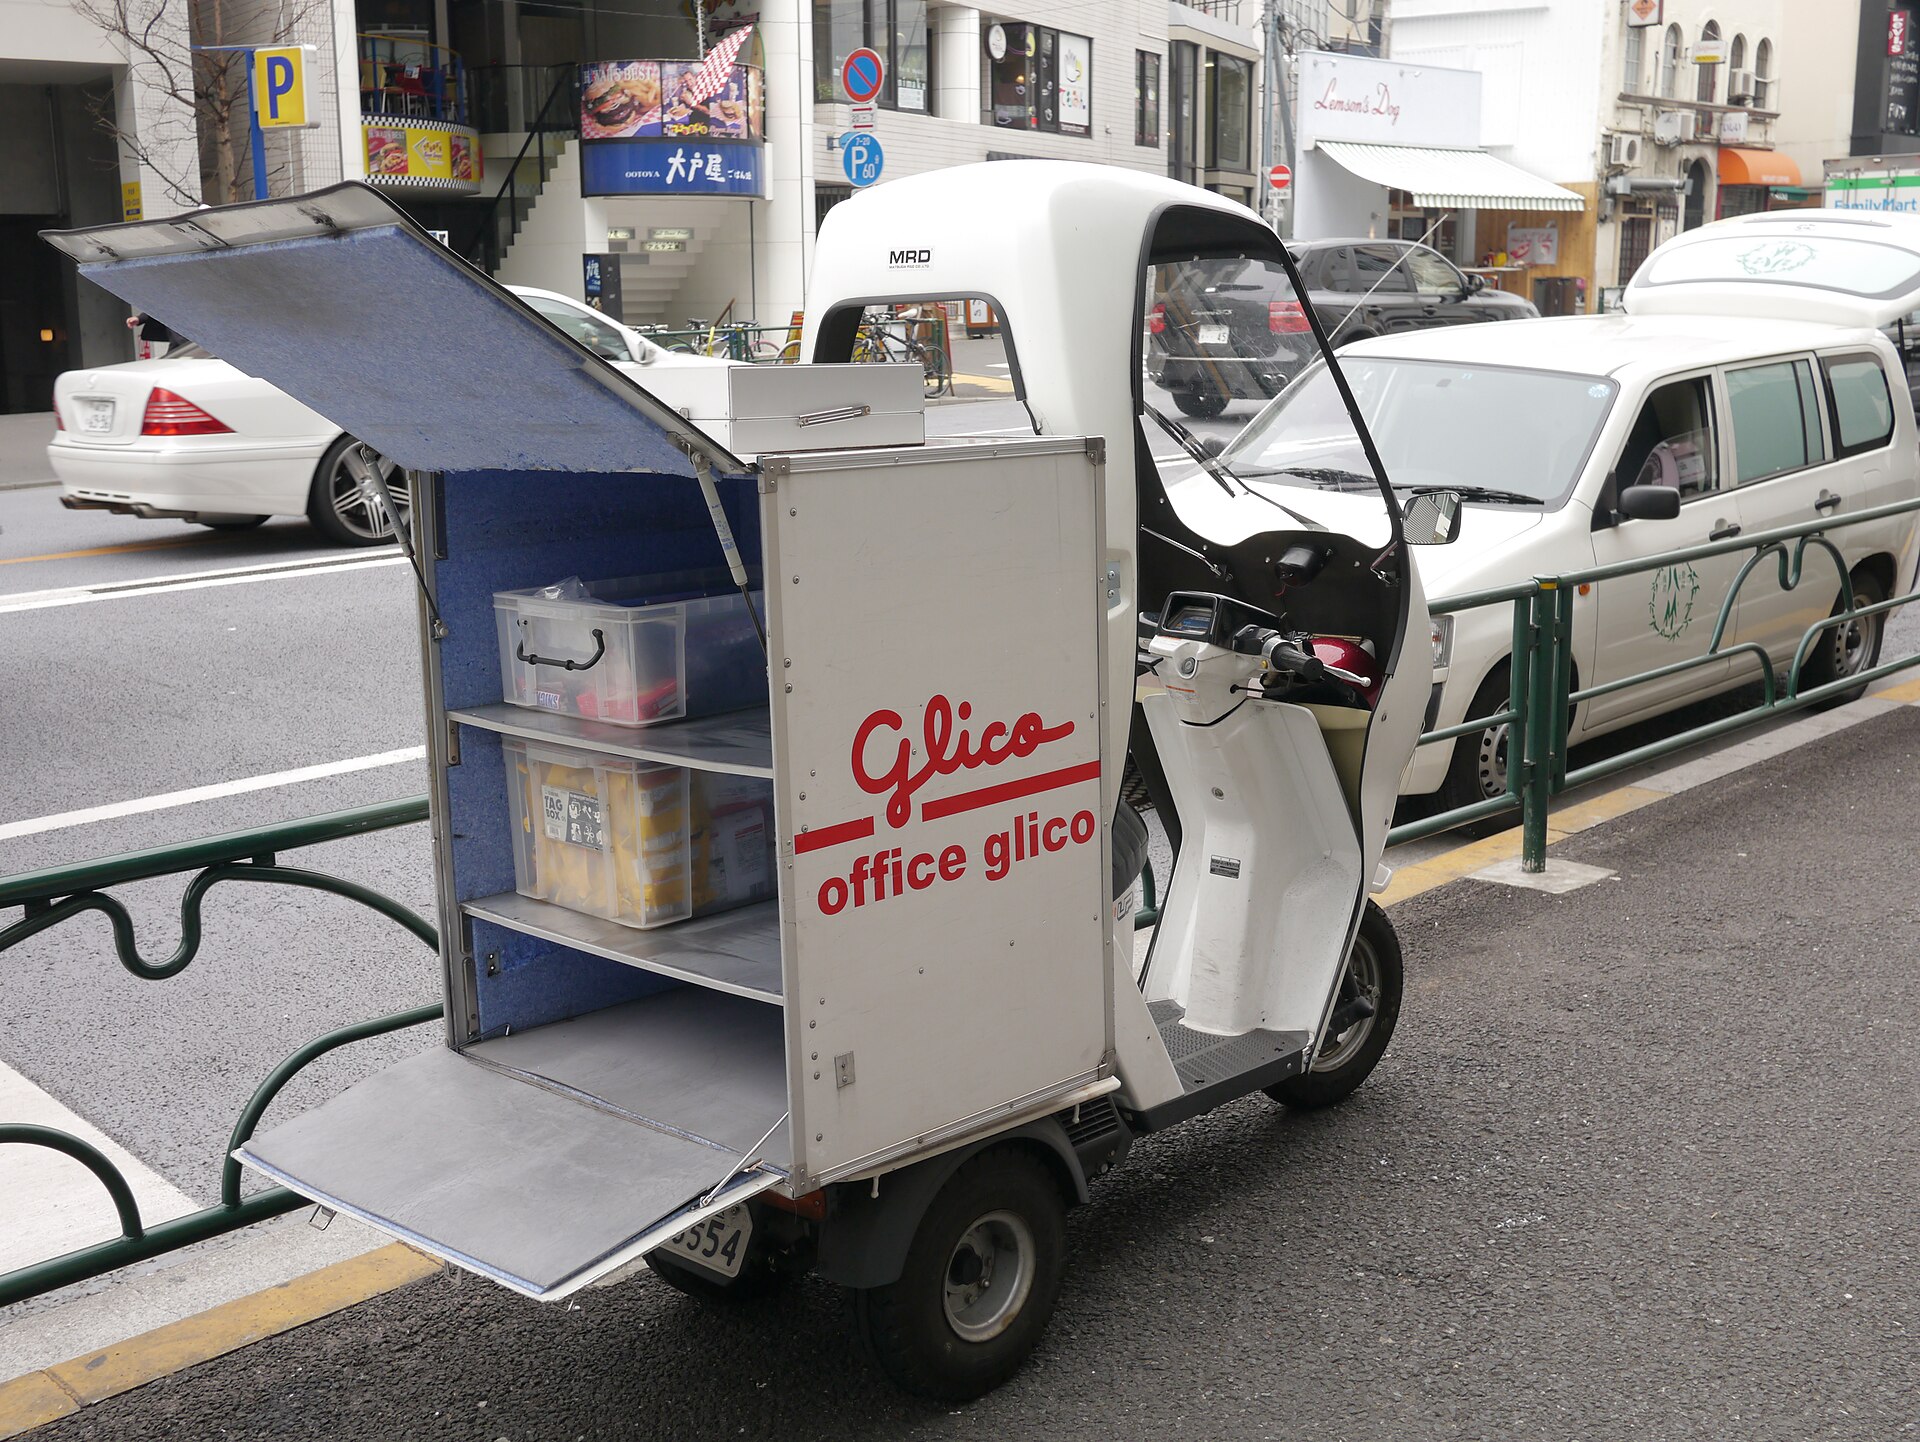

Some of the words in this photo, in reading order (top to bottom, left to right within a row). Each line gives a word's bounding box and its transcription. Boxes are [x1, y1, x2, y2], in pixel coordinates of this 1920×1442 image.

[267, 56, 294, 119] P
[624, 67, 653, 81] BEST
[1314, 77, 1369, 113] Lemson's
[1371, 82, 1400, 126] Dog
[625, 170, 661, 178] OOTOYA
[665, 147, 726, 185] 大戸屋
[852, 146, 868, 179] P
[889, 249, 931, 264] MRD
[852, 694, 1075, 828] Glico
[544, 795, 563, 811] TAG
[546, 808, 561, 820] BOX
[817, 844, 966, 916] office
[984, 810, 1095, 881] glico
